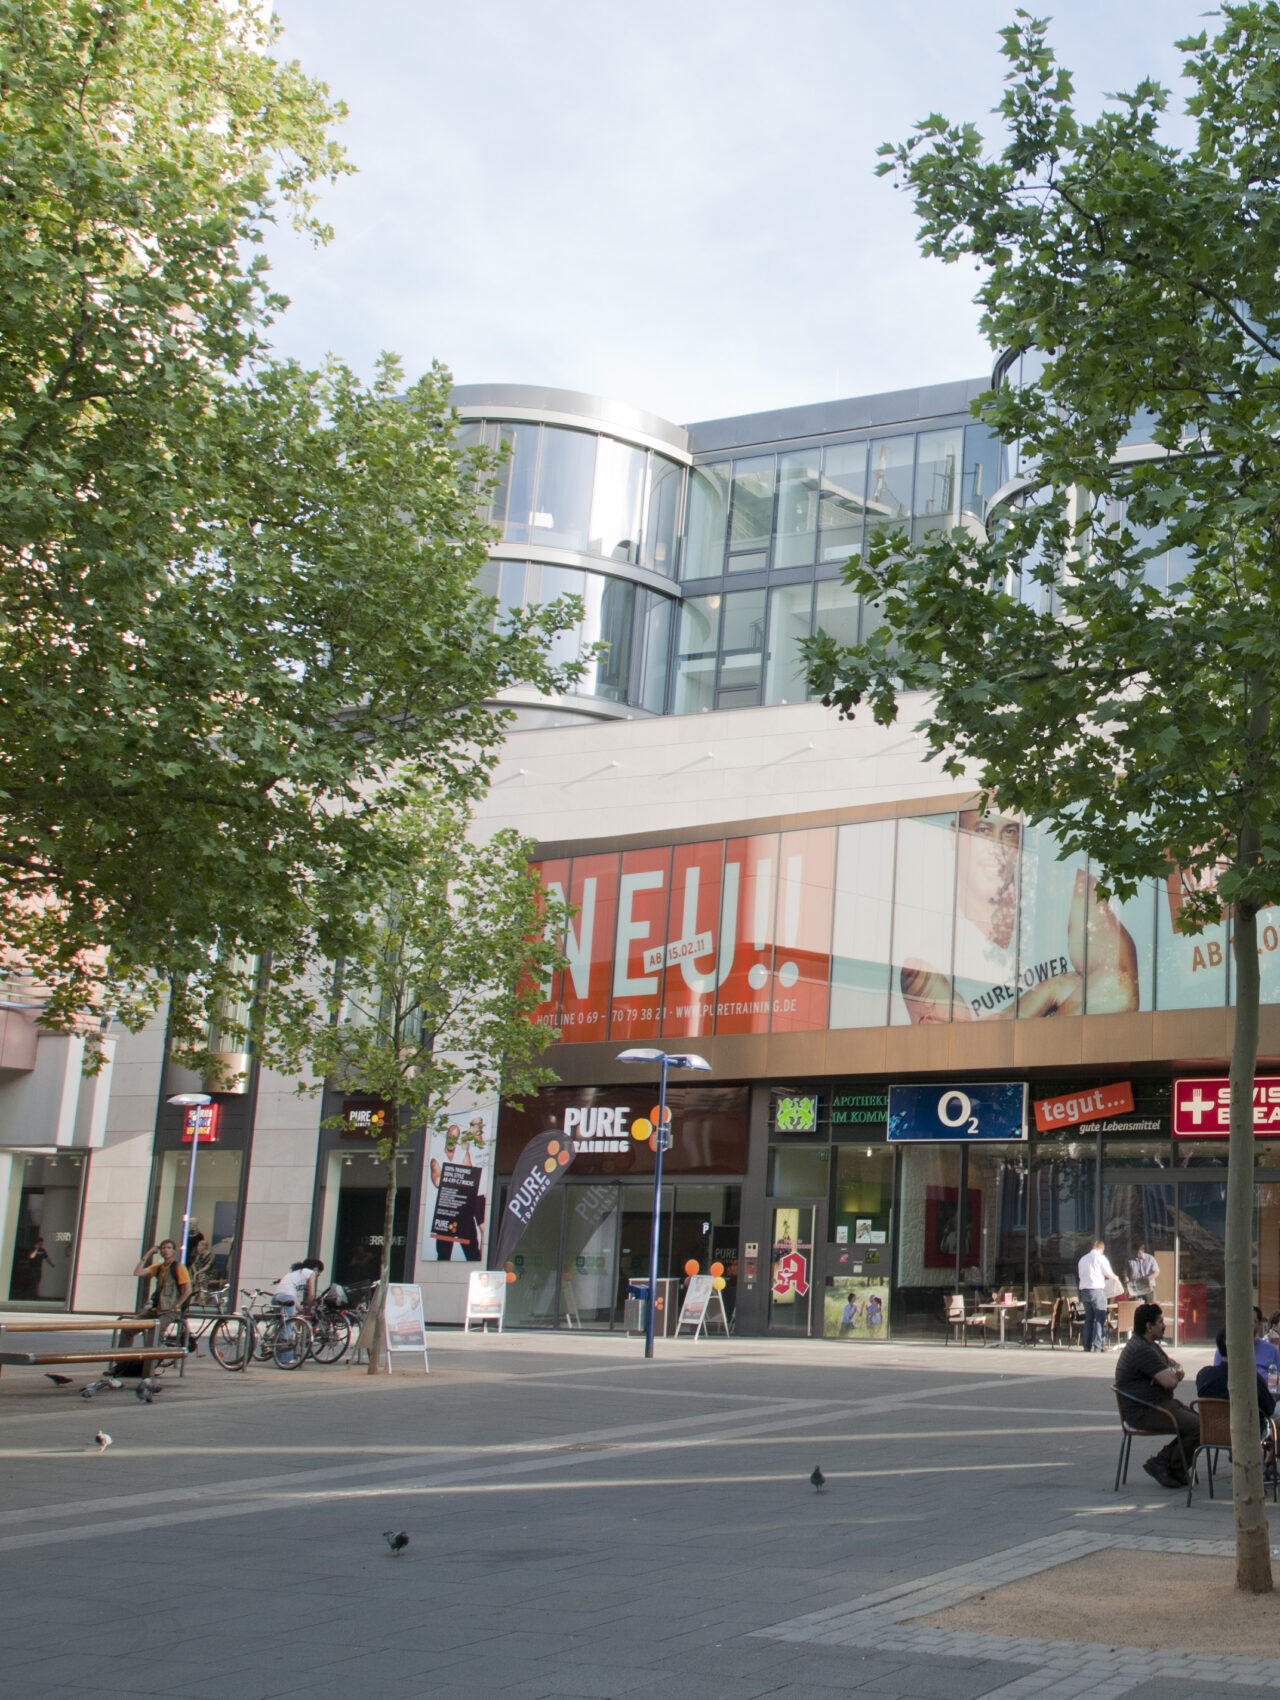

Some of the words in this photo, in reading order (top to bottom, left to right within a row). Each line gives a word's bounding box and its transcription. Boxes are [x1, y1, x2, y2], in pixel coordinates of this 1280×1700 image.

[540, 855, 802, 1002] NEU!!
[650, 951, 663, 966] AB
[668, 939, 706, 961] 15.02.11
[1192, 941, 1223, 972] AB
[537, 1011, 575, 1027] HOTLINE
[586, 1011, 599, 1024] 69
[612, 1009, 624, 1022] 70
[626, 1008, 638, 1021] 79
[640, 1008, 653, 1021] 38
[349, 1110, 372, 1122] PURE
[832, 1111, 847, 1123] IM
[1041, 1089, 1125, 1122] tegut...
[563, 1107, 631, 1137] PURE
[1079, 1123, 1100, 1134] gute
[1102, 1120, 1161, 1132] Lebensmittel
[508, 1165, 547, 1219] PURE
[520, 1178, 552, 1225] TRAINING
[714, 1247, 737, 1259] PURE
